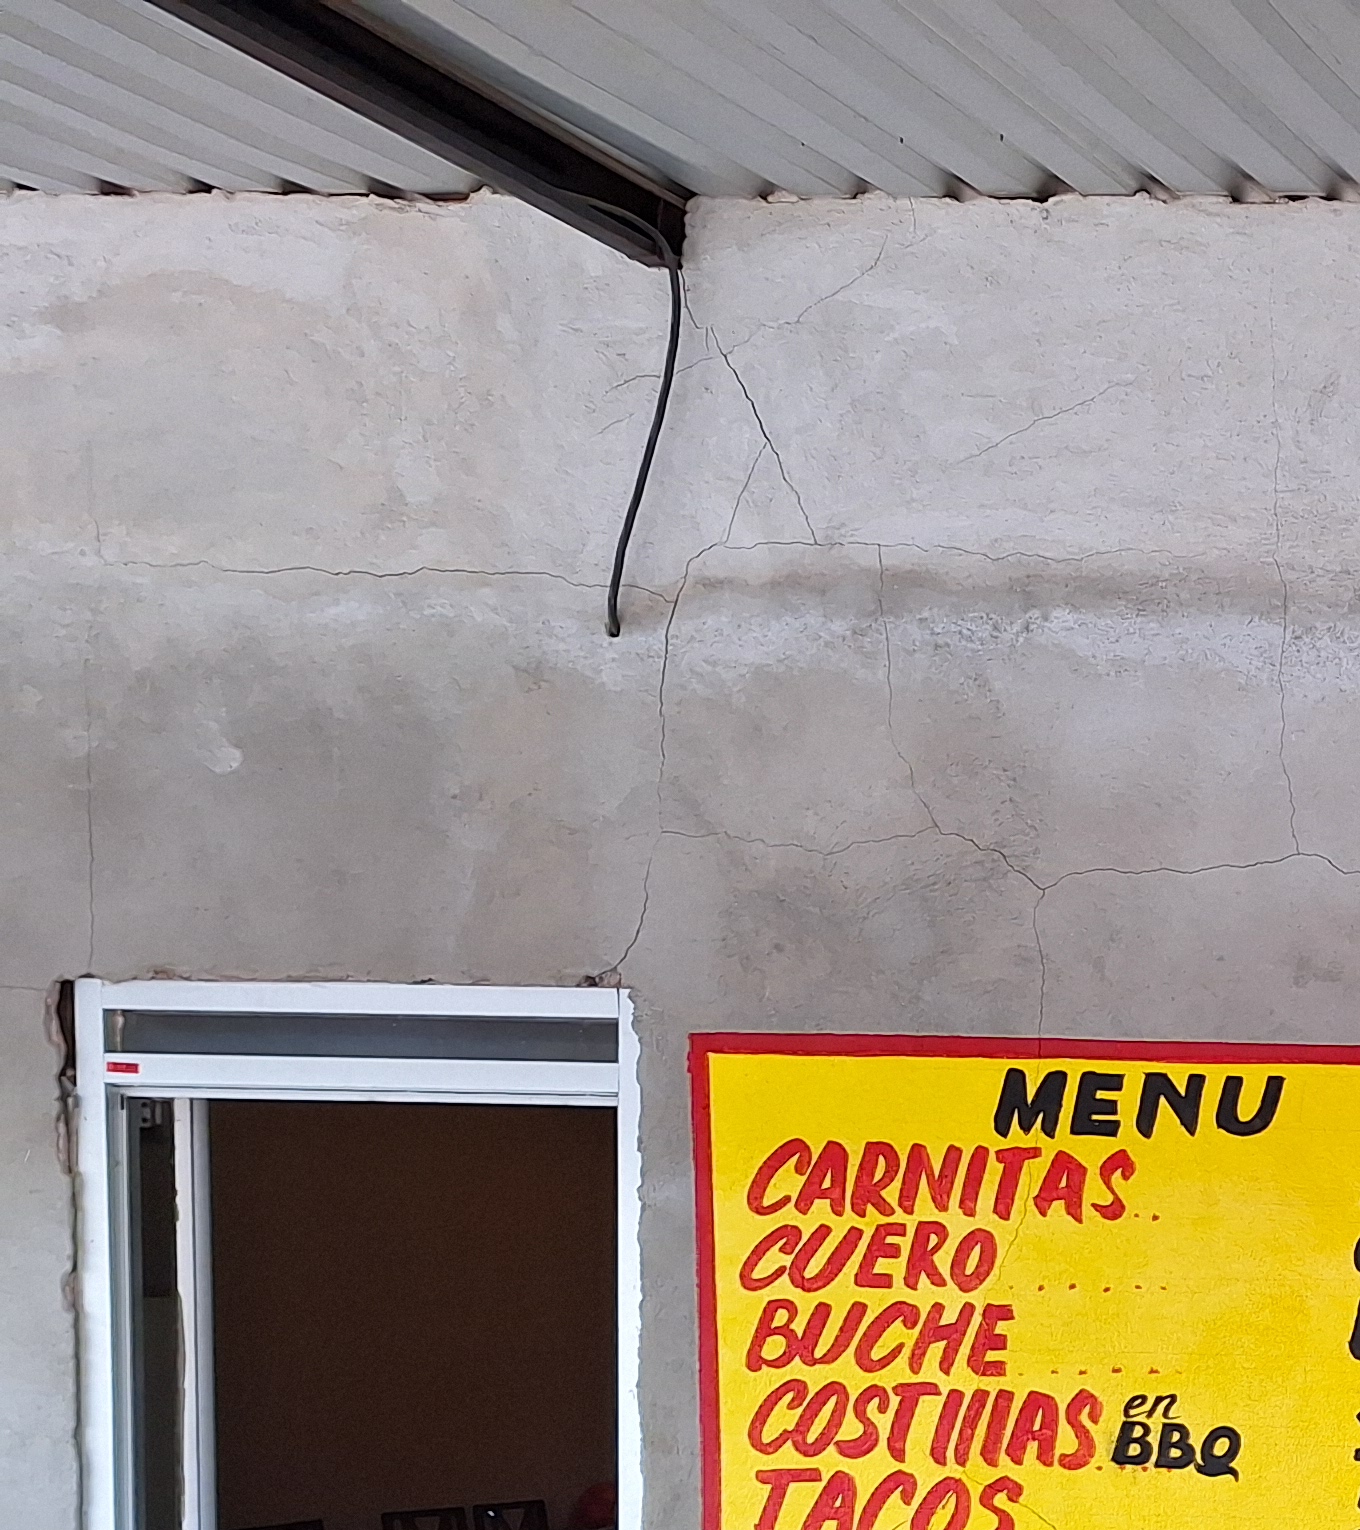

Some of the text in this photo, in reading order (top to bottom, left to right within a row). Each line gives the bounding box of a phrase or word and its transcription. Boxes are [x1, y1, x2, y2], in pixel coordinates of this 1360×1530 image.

[993, 1067, 1286, 1140] MENU
[746, 1137, 1136, 1224] CARNITAS
[738, 1220, 999, 1293] CUERO
[745, 1298, 1016, 1378] BUCHE
[1122, 1392, 1179, 1420] en
[1111, 1420, 1241, 1481] BBQ
